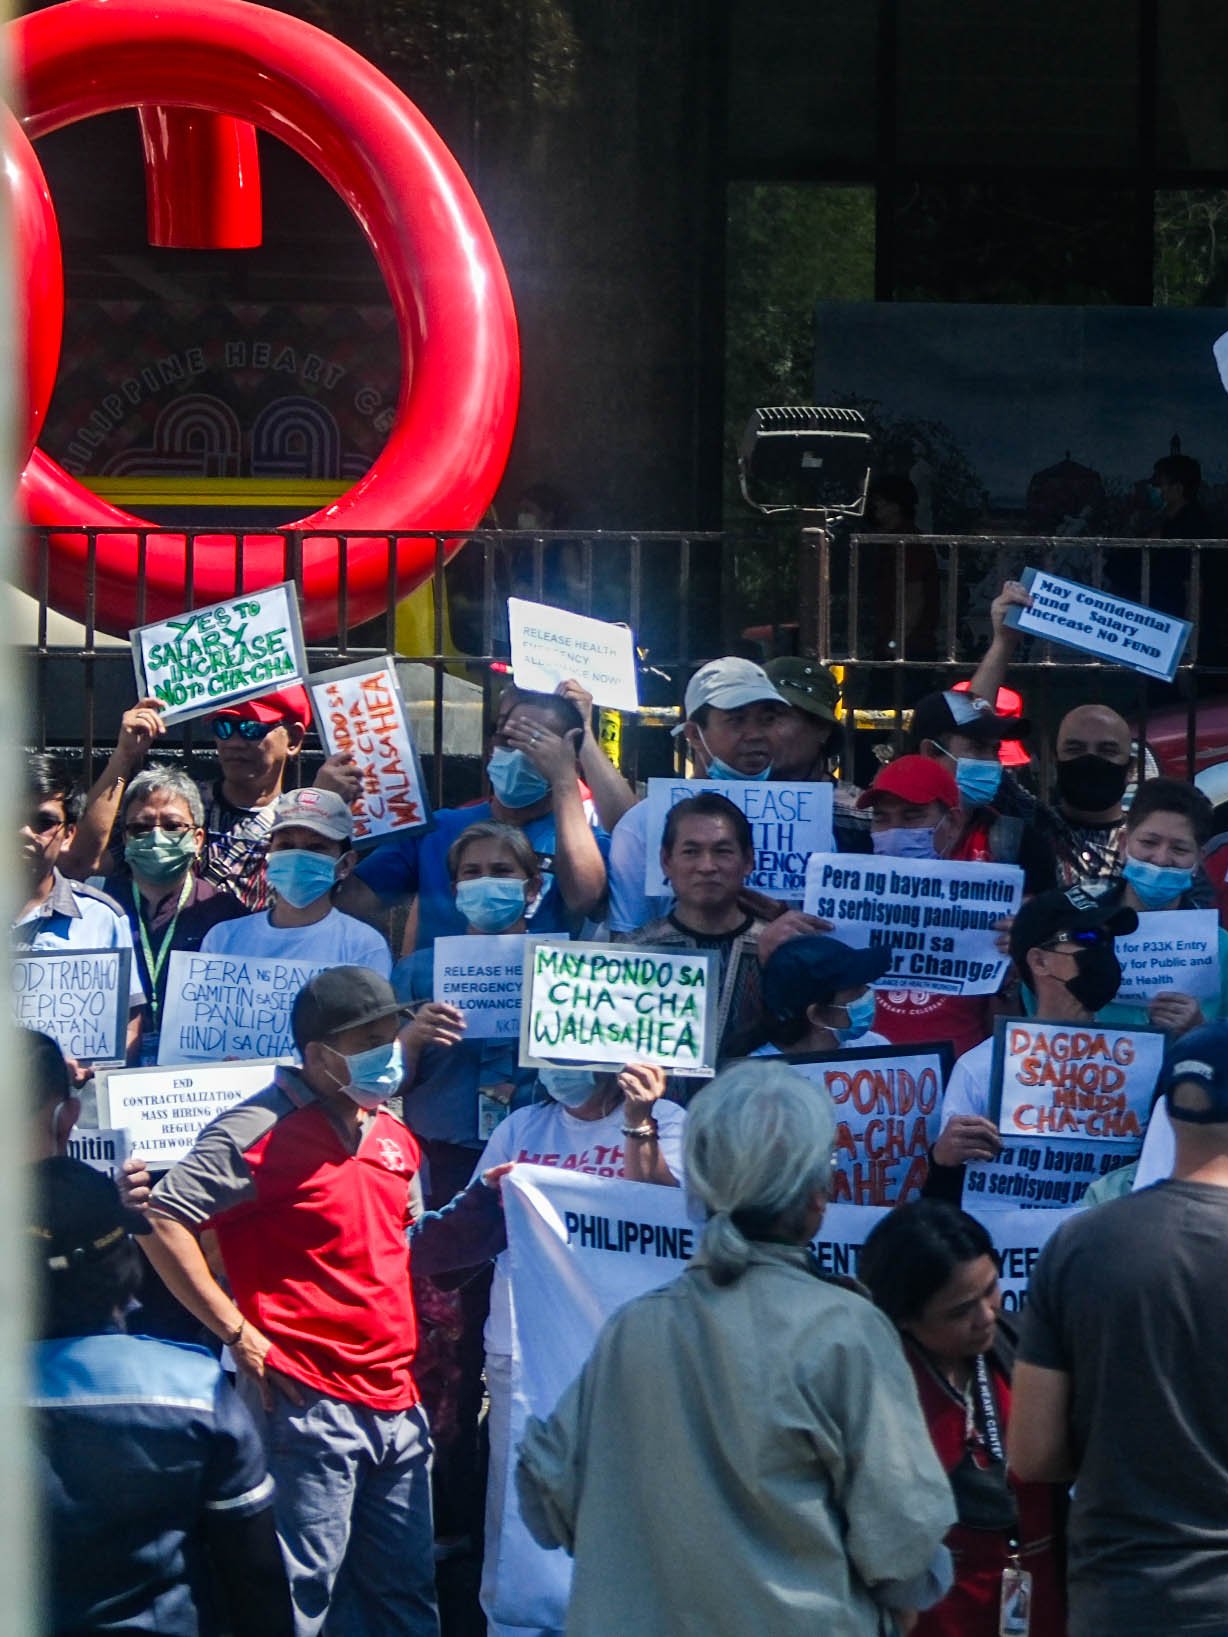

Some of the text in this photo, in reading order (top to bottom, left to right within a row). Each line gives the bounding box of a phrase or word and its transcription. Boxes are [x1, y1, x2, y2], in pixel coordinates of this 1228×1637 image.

[224, 341, 348, 389] HEART
[166, 600, 262, 641] YES TO
[1031, 592, 1140, 637] Fund Salary
[1039, 579, 1171, 634] May Confidential
[148, 622, 248, 671] SALARY
[522, 626, 573, 647] RELEASE
[1026, 606, 1162, 659] Increase NO FUND
[170, 627, 287, 683] INCREASE
[207, 651, 295, 697] CHA-CHA
[361, 671, 400, 736] HEA
[380, 759, 423, 827] WALA
[821, 864, 1015, 903] Pera ng bayan, gamitin
[817, 896, 835, 918] sa
[838, 897, 921, 928] serbisyong
[869, 929, 954, 953] HINDI sa
[1123, 942, 1139, 953] for
[1143, 941, 1172, 952] P33K
[1176, 940, 1207, 952] Entry
[48, 958, 117, 991] TRABAHO
[189, 958, 251, 985] PERA
[444, 965, 501, 977] RELEASE
[536, 950, 705, 988] MAY PONDO SA
[909, 953, 1003, 982] Change!
[1131, 958, 1147, 969] for
[1150, 957, 1186, 968] Public
[1190, 956, 1212, 966] and
[1136, 974, 1173, 985] Health
[181, 982, 252, 1007] GAMITIN
[443, 982, 522, 993] EMERGENCY
[549, 981, 699, 1018] CHA-CHA
[180, 1025, 227, 1052] HINDI
[232, 1034, 251, 1050] SA
[533, 1010, 699, 1058] WALA SA HEA
[1009, 1028, 1136, 1066] DAGDAG
[173, 1078, 194, 1090] END
[823, 1067, 939, 1116] PONDO
[1016, 1056, 1127, 1094] SAHOD
[123, 1090, 242, 1107] CONTRACTUALIZATION
[141, 1109, 168, 1121] MASS
[172, 1106, 212, 1119] HIRING
[162, 1121, 205, 1135] REGULA
[1012, 1103, 1143, 1138] CHA-CHA
[1018, 1146, 1040, 1171] ng
[1043, 1144, 1097, 1173] bayan,
[966, 1170, 986, 1191] sa
[987, 1171, 1071, 1200] serbisyong
[564, 1211, 694, 1260] PHILIPPINE
